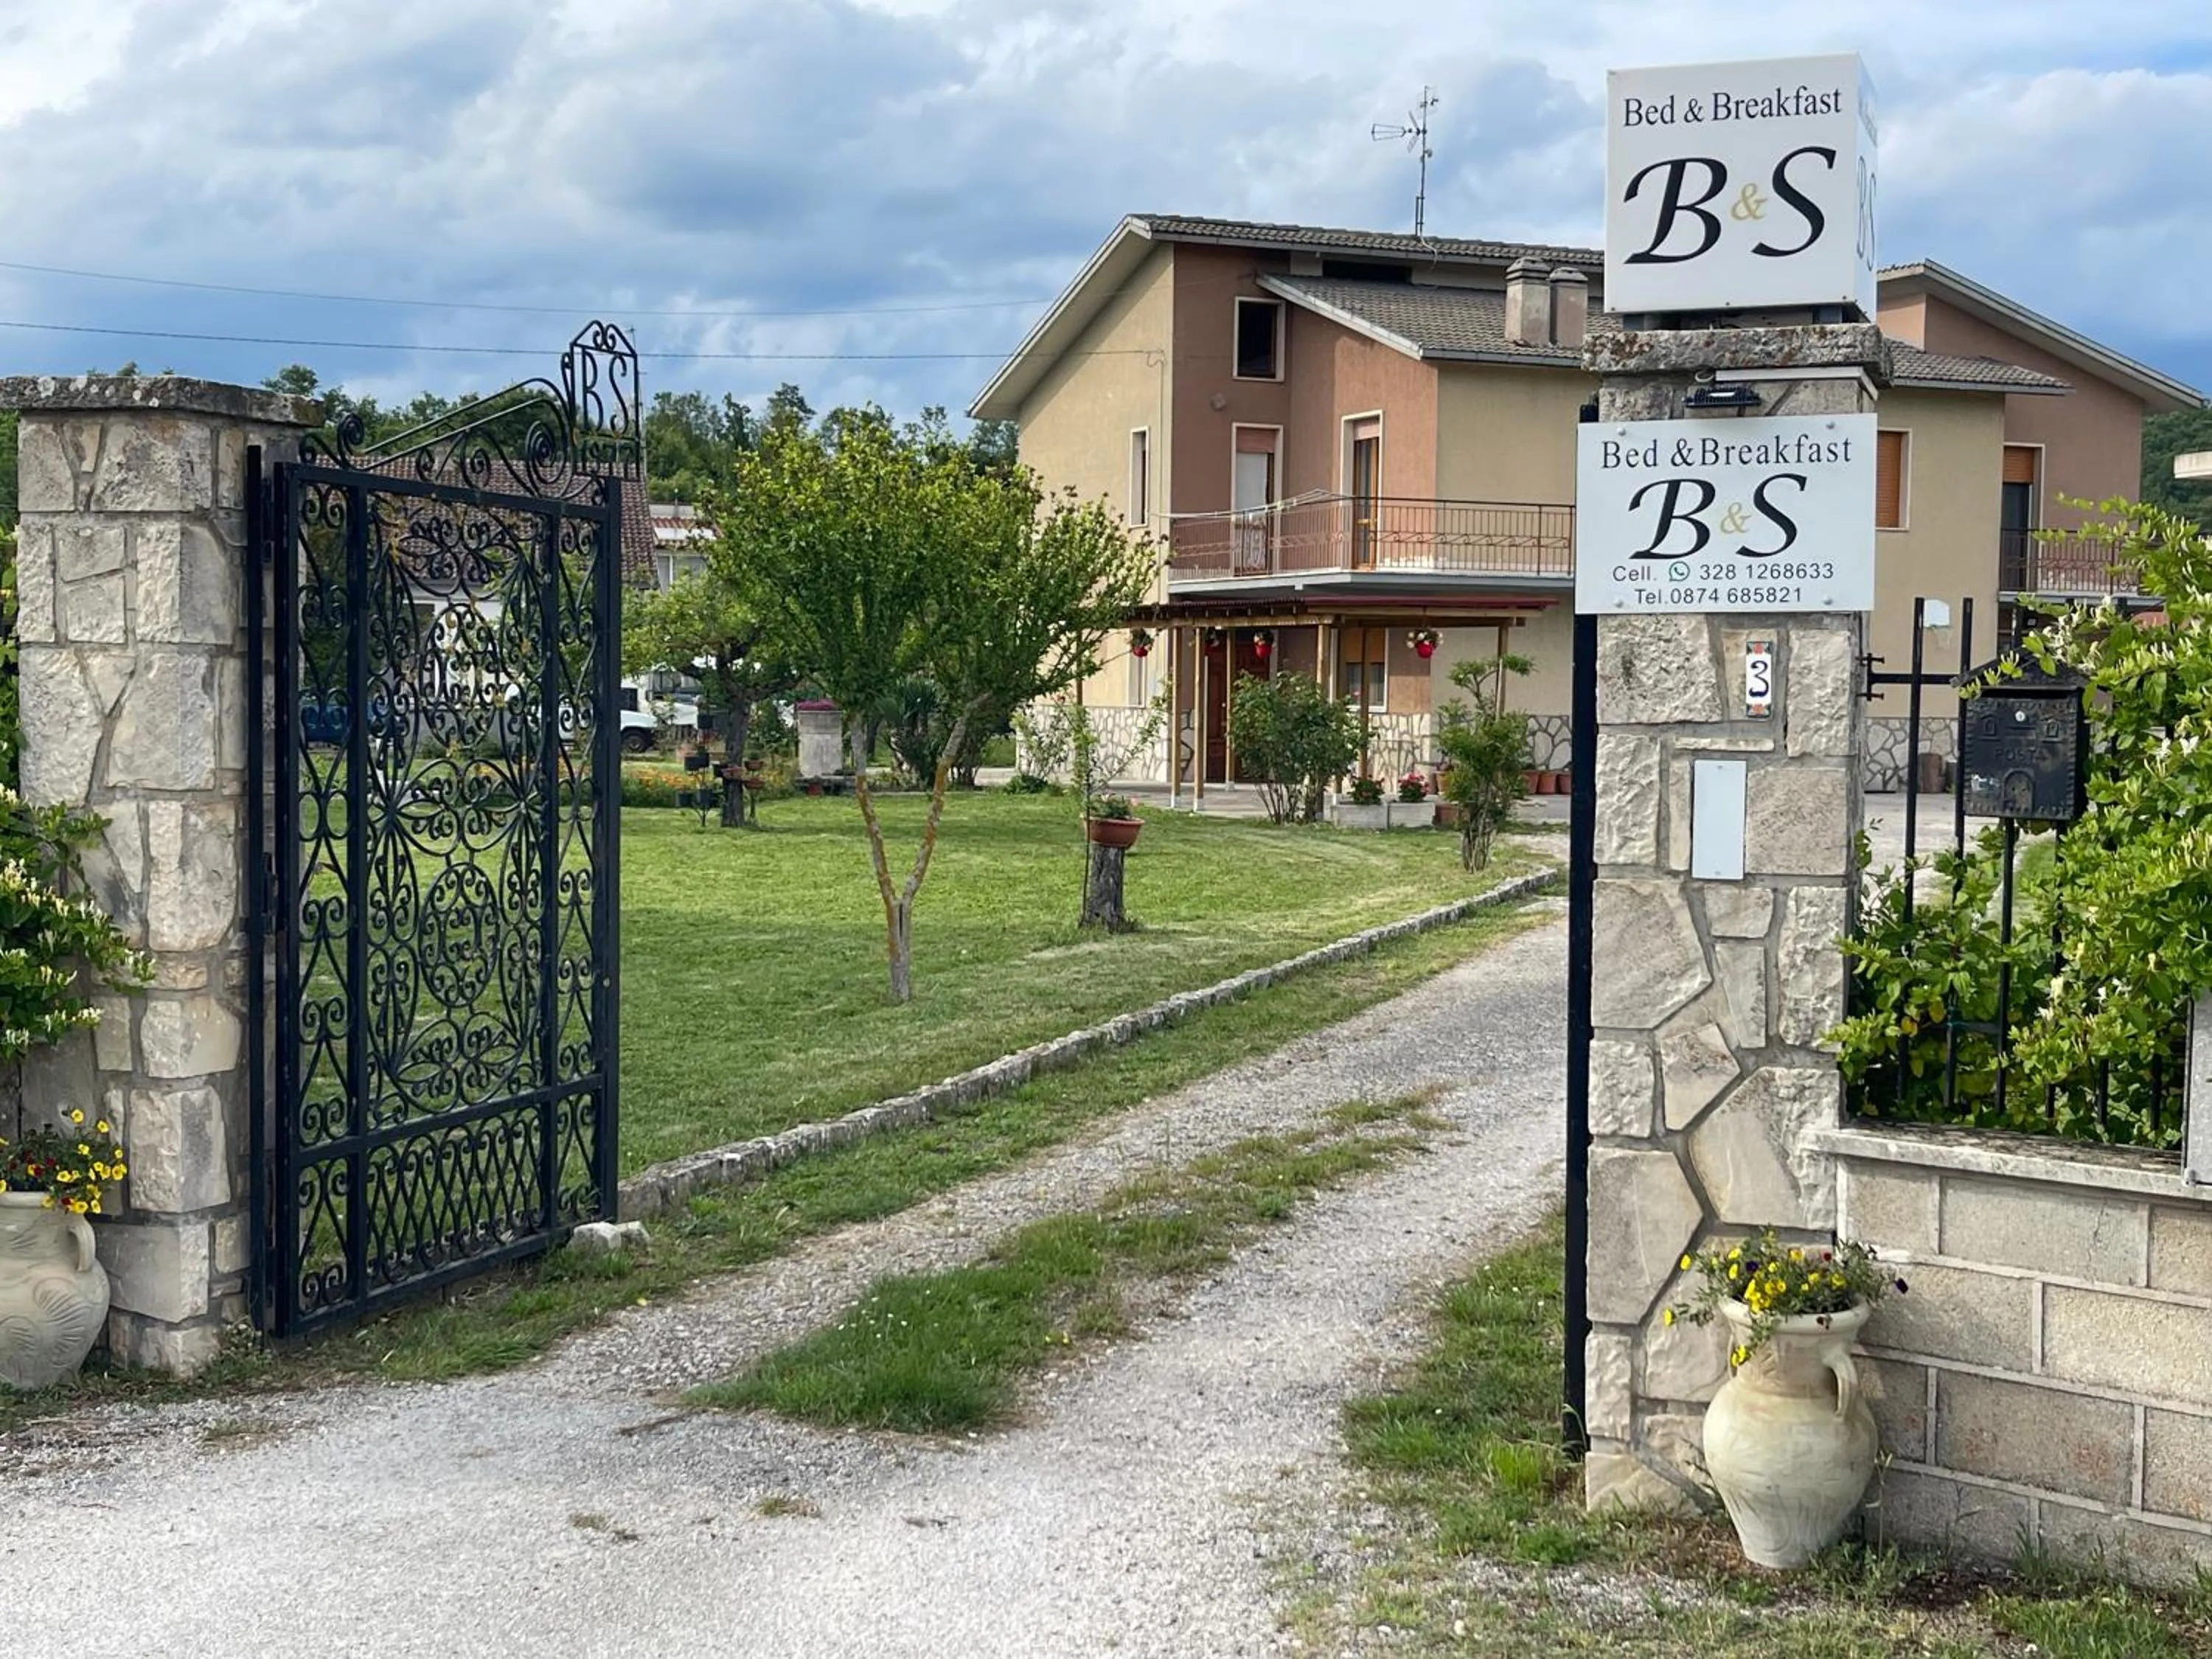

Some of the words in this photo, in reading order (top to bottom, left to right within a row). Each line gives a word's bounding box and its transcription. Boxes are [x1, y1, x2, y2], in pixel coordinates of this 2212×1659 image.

[1624, 95, 1675, 126] Bed
[1684, 99, 1704, 122] &
[1712, 86, 1842, 121] Breakfast
[1603, 439, 1658, 468] Bed
[1613, 566, 1657, 581] Cell.
[1700, 564, 1736, 580] 328
[1747, 563, 1833, 579] 1268633
[1728, 587, 1801, 603] 685821
[1748, 660, 1769, 698] 3
[1994, 747, 2050, 762] POSTA
